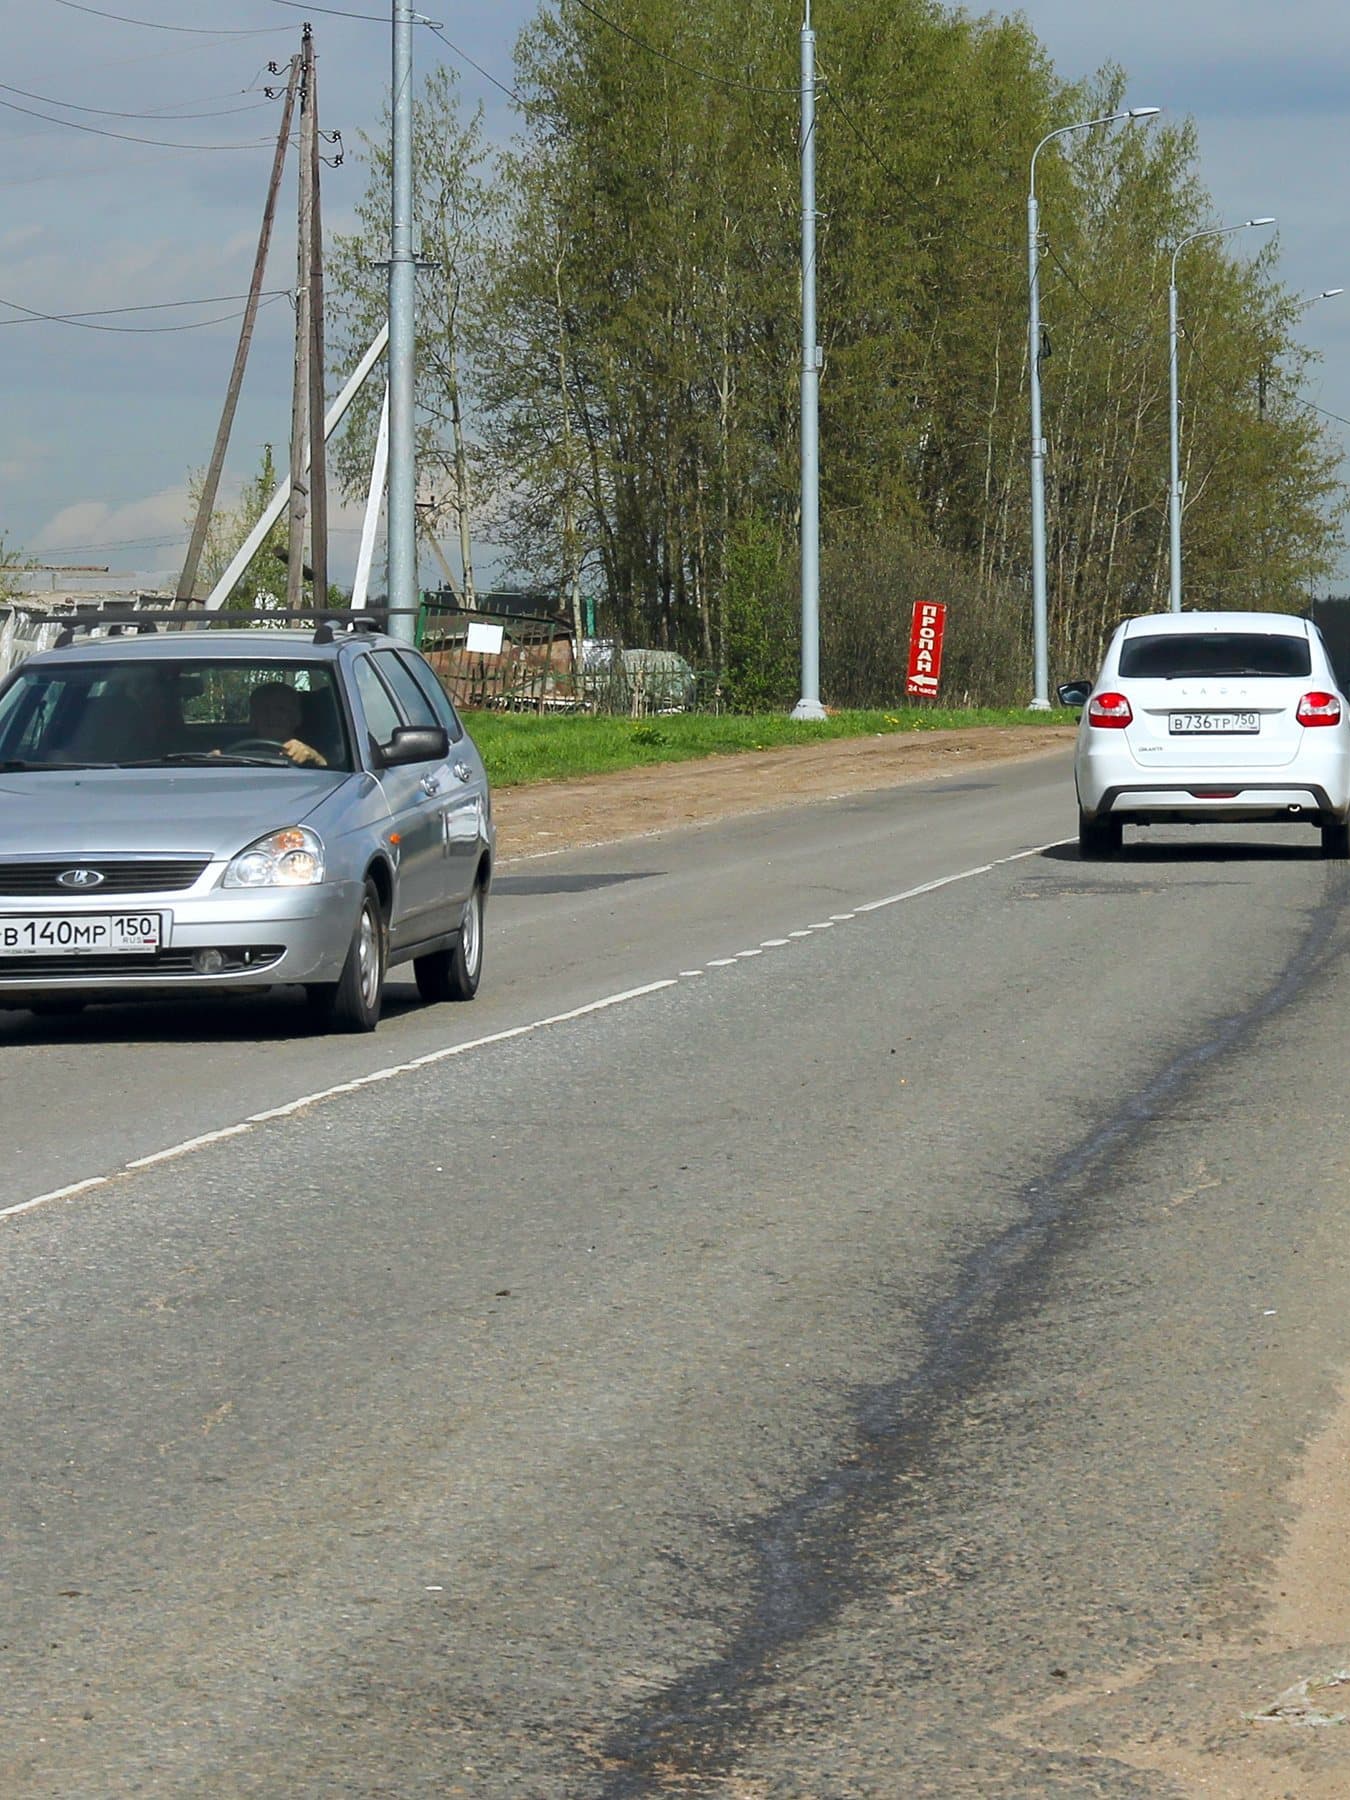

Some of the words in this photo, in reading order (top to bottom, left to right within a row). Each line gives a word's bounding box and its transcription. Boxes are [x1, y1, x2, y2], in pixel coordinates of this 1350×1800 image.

[917, 605, 937, 672] ПРОПАН
[1174, 715, 1231, 730] В736ТР
[1234, 713, 1255, 725] 750
[4, 921, 106, 946] В140МР
[114, 918, 151, 936] 150
